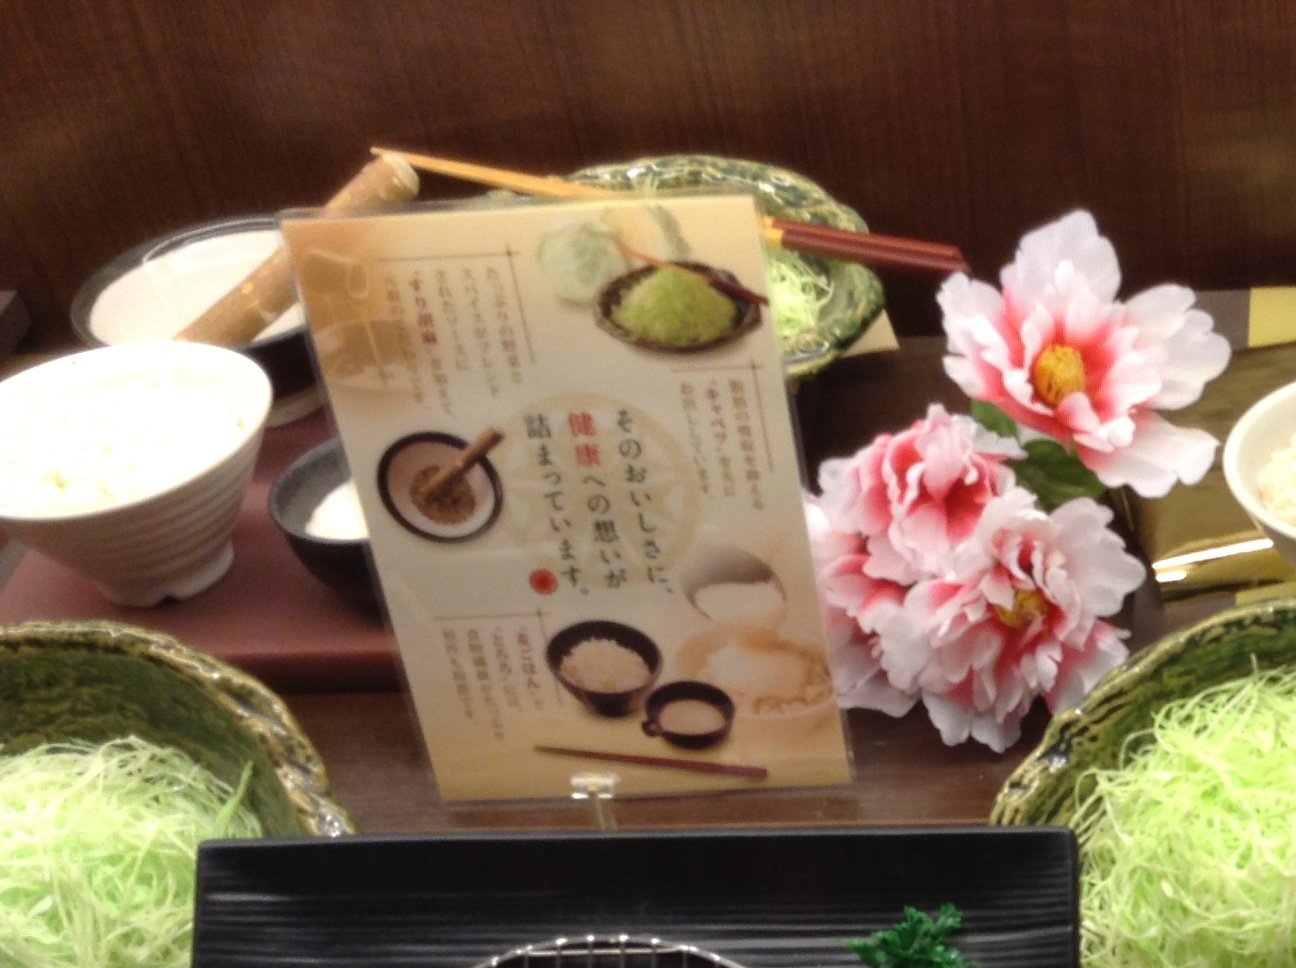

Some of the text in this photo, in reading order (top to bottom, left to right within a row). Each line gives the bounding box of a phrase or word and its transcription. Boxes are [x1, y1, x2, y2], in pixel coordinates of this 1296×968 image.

[524, 413, 590, 596] 詰まっています。
[567, 411, 628, 589] 健康への想いが
[615, 409, 674, 595] そのおいしさに、
